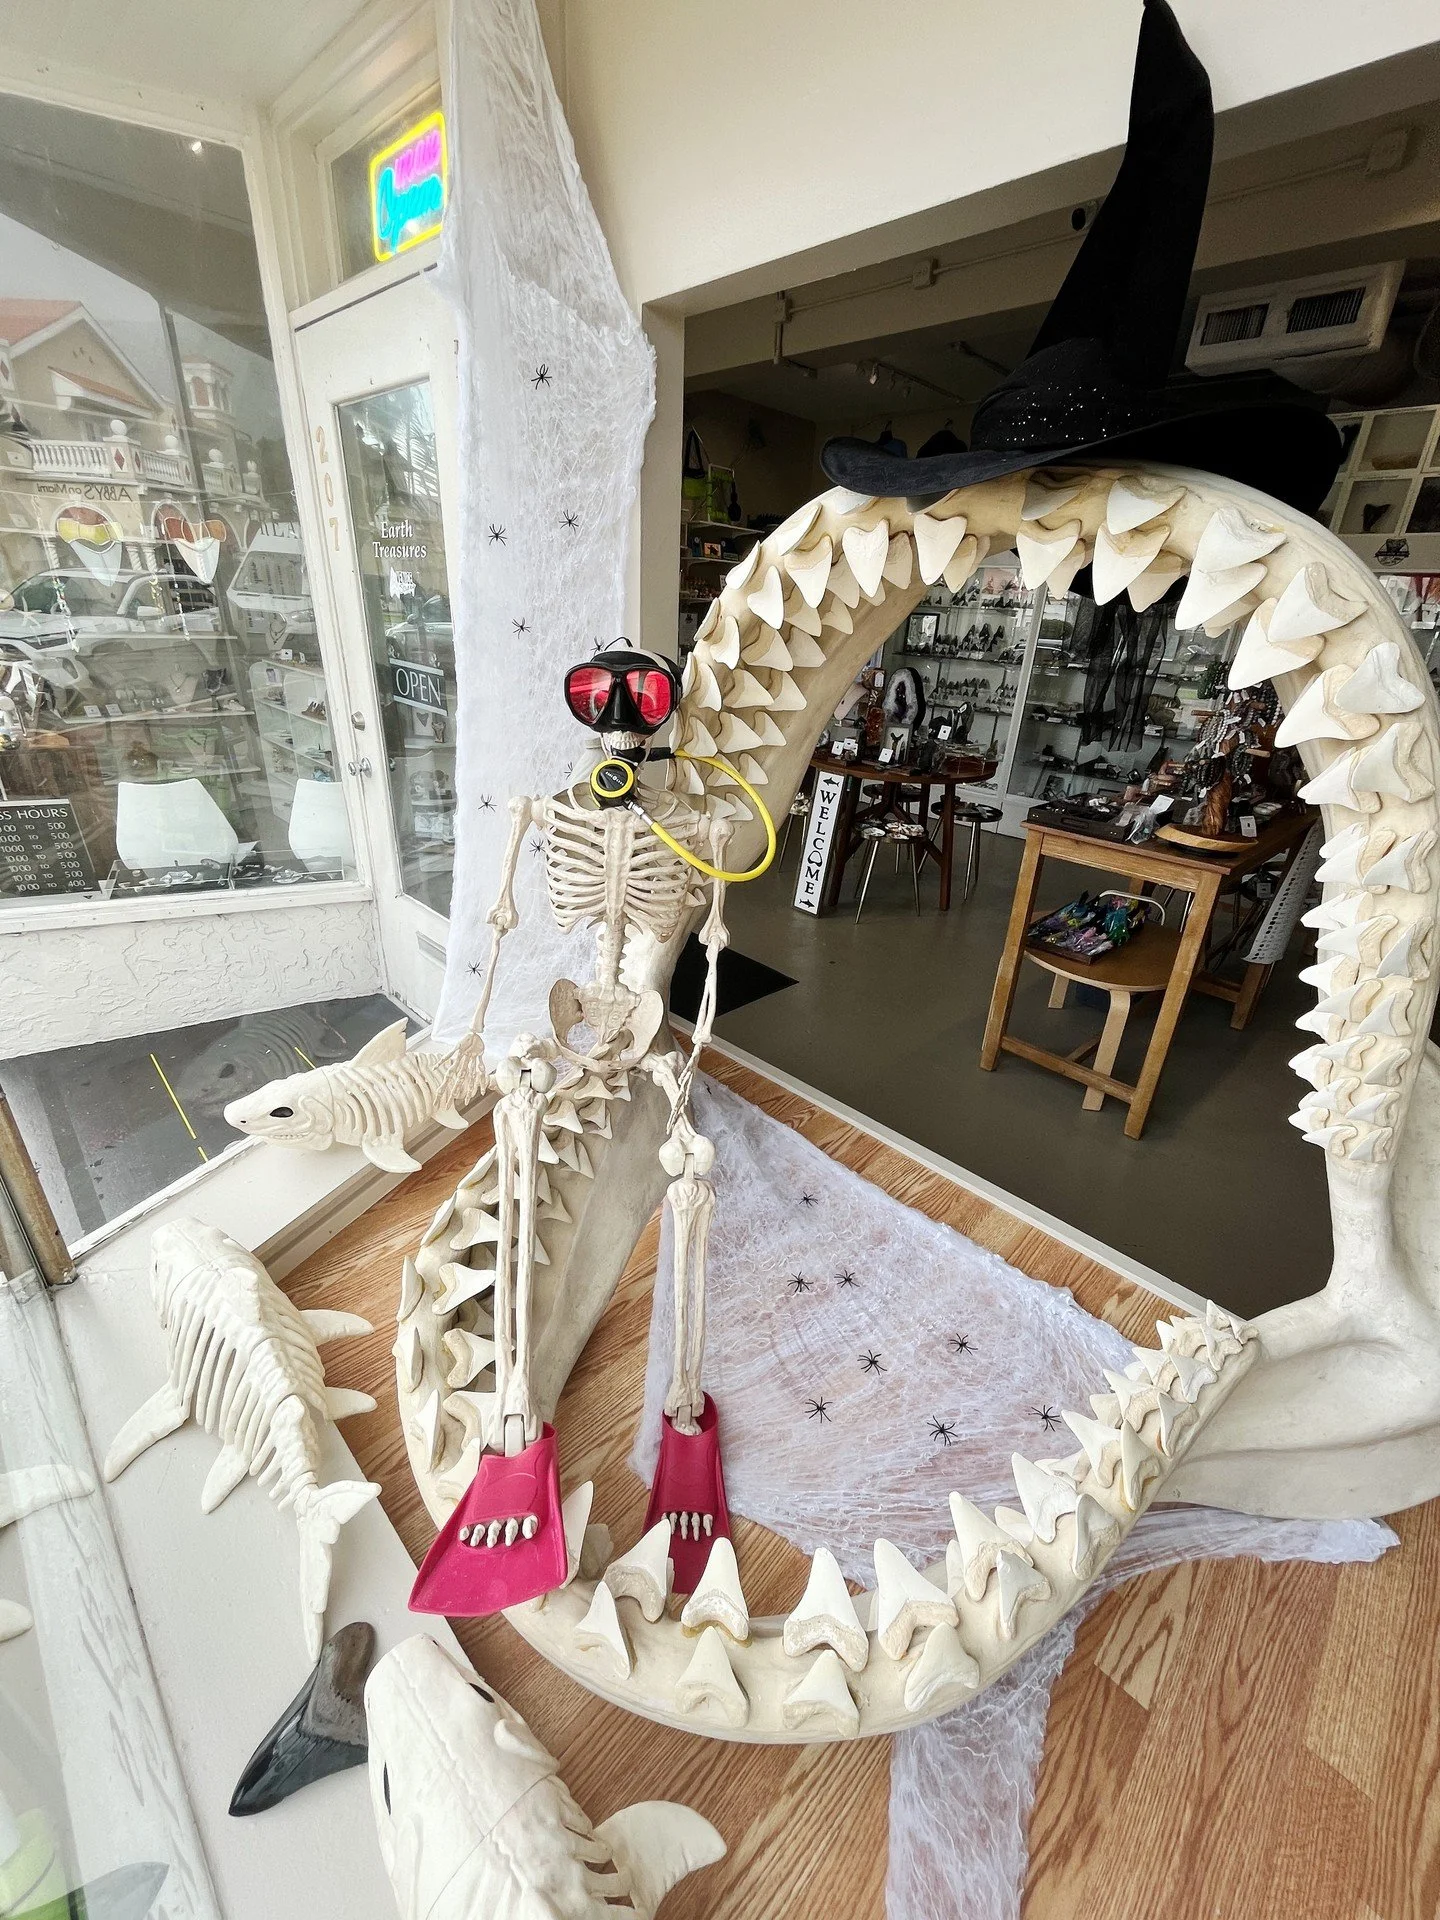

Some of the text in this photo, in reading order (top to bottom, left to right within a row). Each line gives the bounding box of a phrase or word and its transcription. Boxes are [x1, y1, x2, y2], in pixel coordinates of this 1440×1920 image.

[381, 519, 413, 538] Earth
[372, 541, 427, 558] Treasures
[395, 667, 442, 706] OPEN
[16, 808, 68, 819] HOURS
